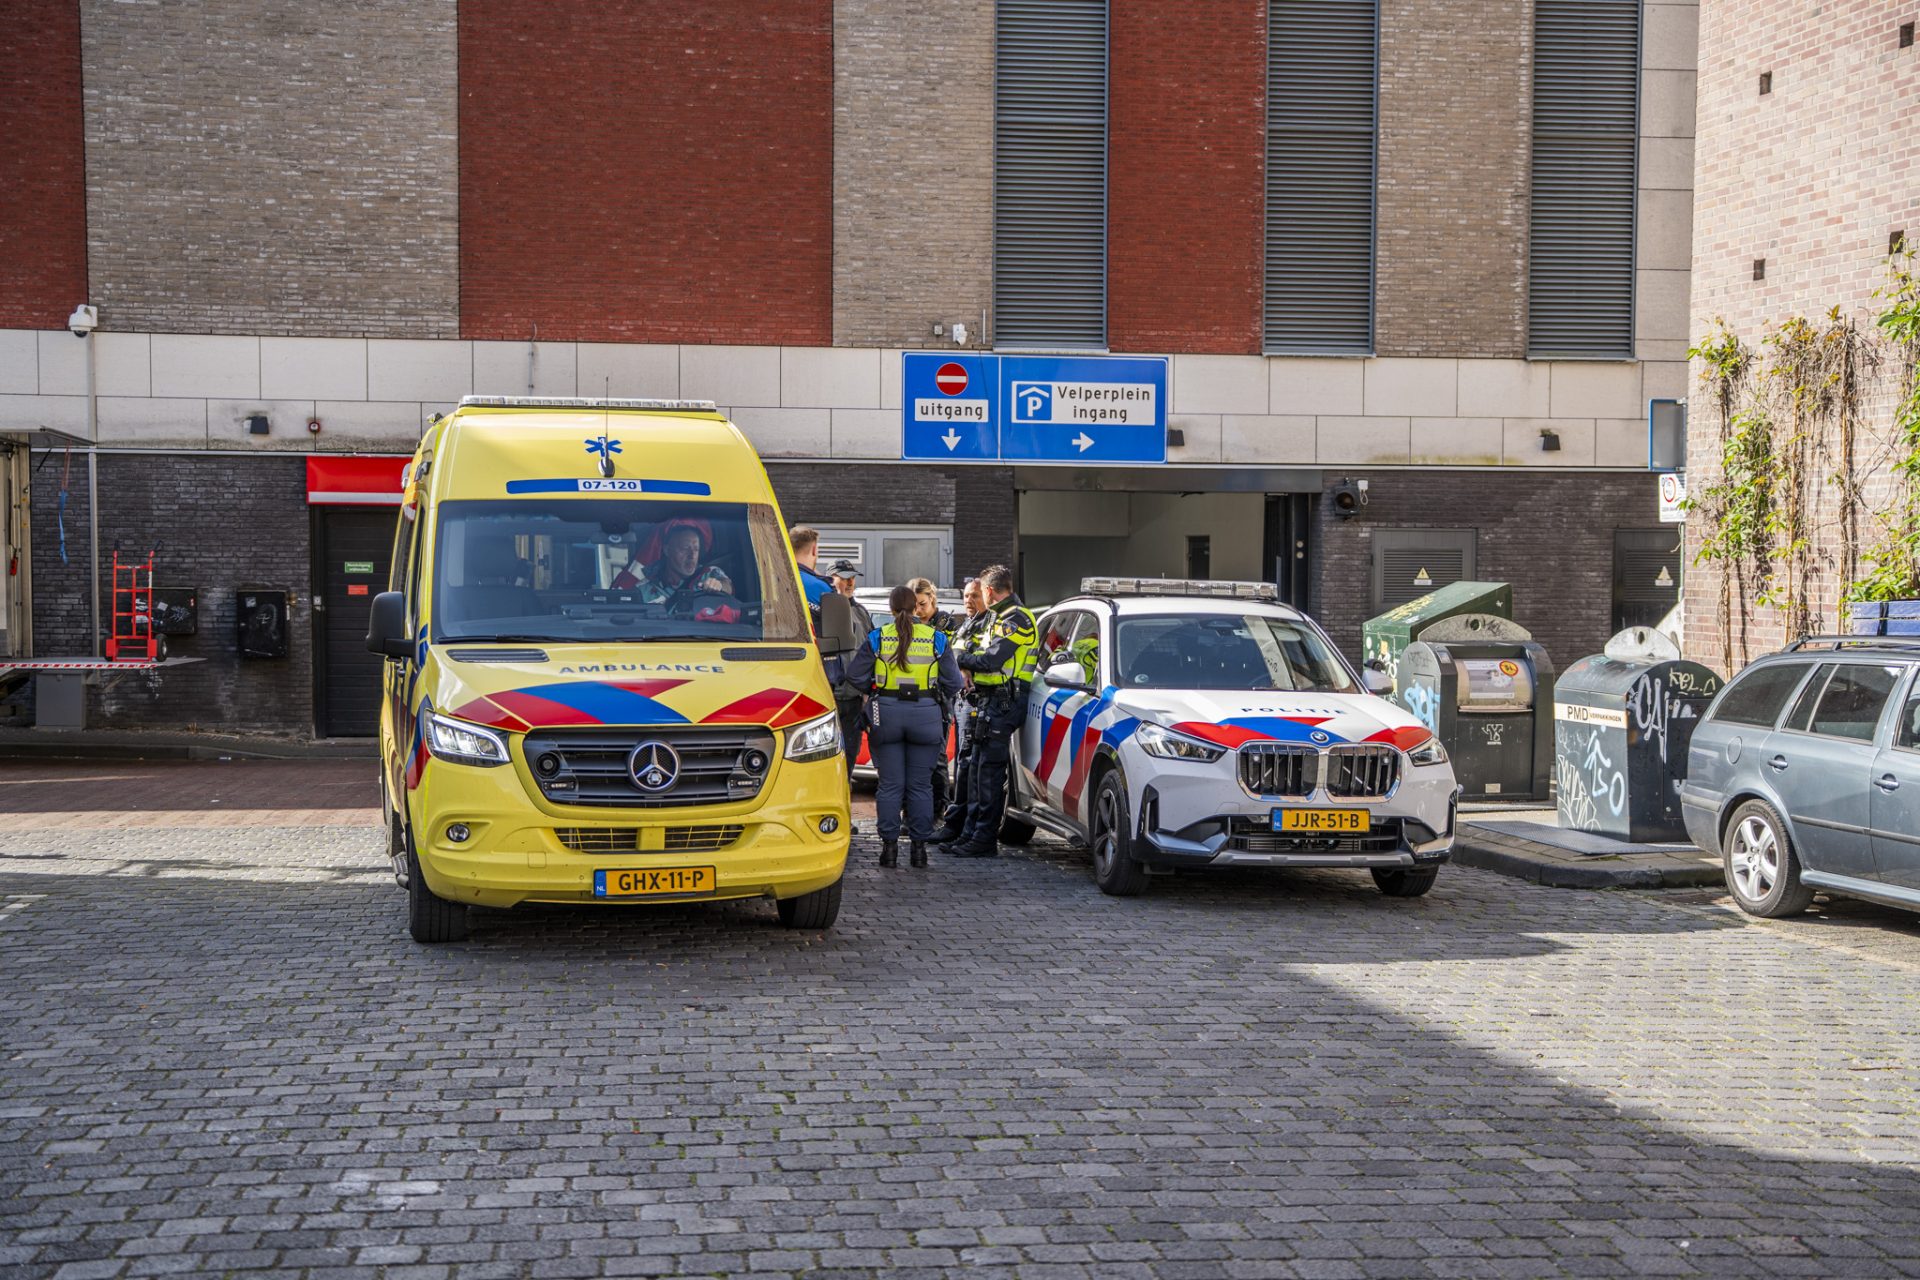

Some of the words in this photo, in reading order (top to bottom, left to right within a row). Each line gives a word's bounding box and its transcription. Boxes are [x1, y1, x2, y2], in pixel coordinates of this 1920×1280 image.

[1057, 386, 1151, 402] Velperplein
[920, 402, 983, 420] uitgang
[1027, 396, 1043, 417] P
[1073, 405, 1128, 422] ingang
[582, 480, 637, 490] 07-120
[559, 664, 726, 674] AMBULANCE
[1567, 705, 1589, 721] PMD
[1291, 813, 1359, 828] JJR-51-B
[618, 870, 704, 891] GHX-11-P
